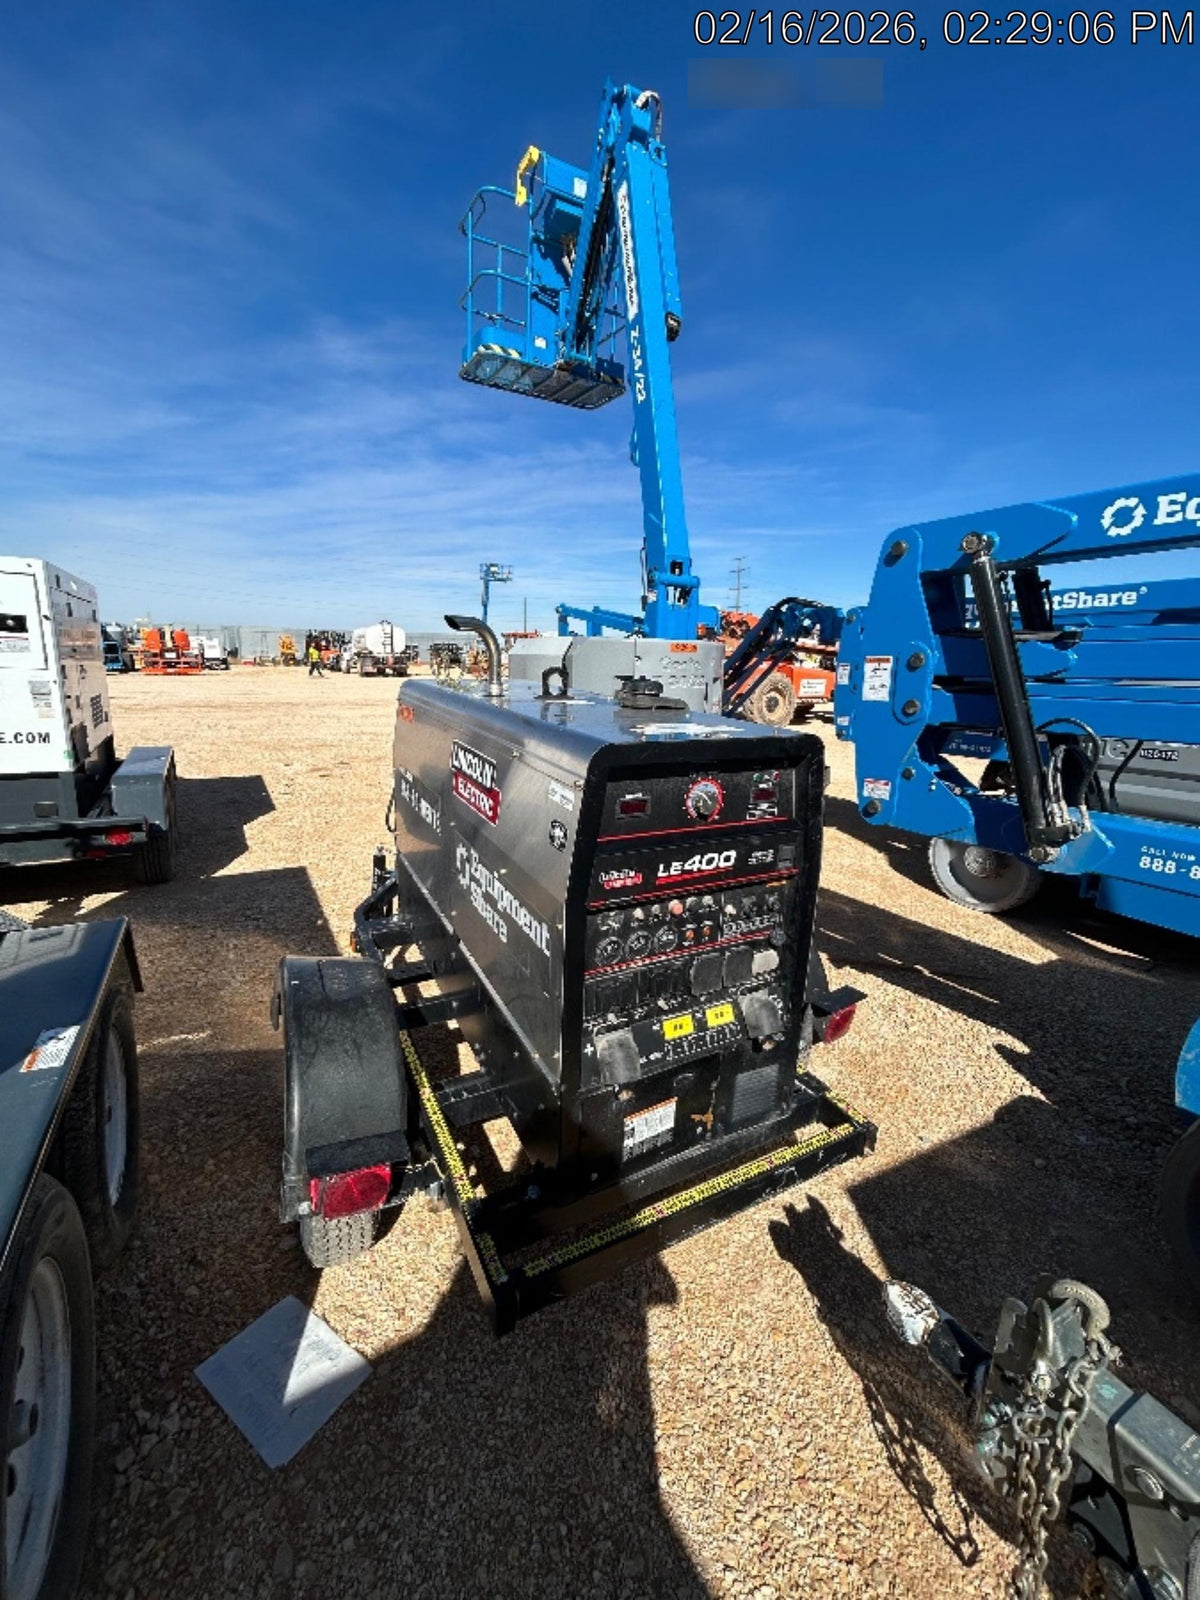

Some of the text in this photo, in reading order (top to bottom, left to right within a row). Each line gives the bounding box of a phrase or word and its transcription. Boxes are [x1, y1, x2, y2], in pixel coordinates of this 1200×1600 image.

[453, 743, 495, 789] LINCOLN
[458, 776, 494, 817] ELECTRIC
[657, 849, 737, 877] LE400
[1141, 845, 1196, 861] CALL NOW
[470, 848, 551, 957] Equipment
[470, 883, 507, 943] Share
